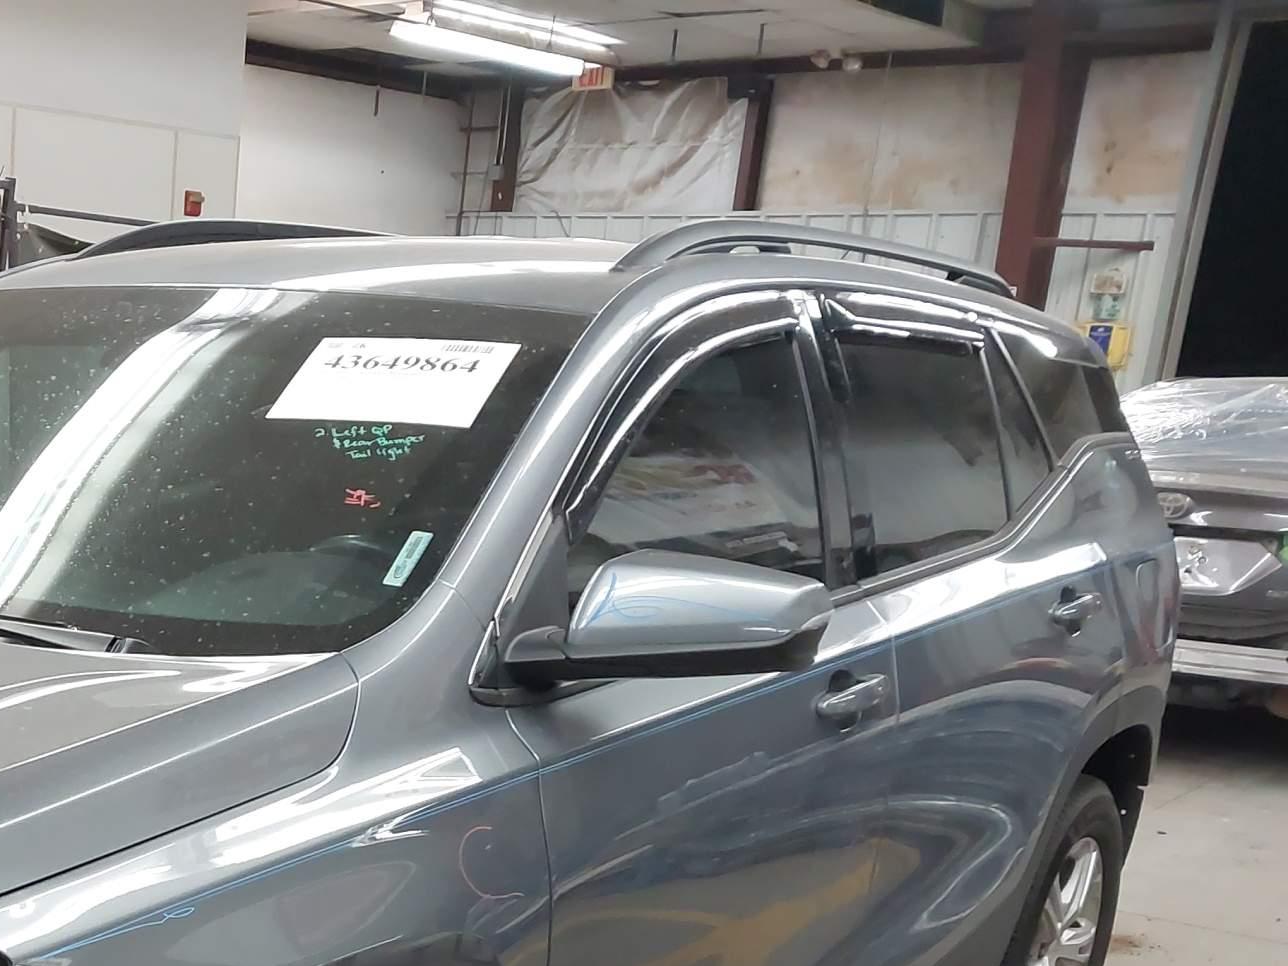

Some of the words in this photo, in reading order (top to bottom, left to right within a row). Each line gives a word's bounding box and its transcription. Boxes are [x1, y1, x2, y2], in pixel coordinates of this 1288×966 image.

[324, 354, 480, 372] 43649864
[331, 425, 367, 438] Left
[343, 439, 377, 448] Rear
[376, 434, 425, 447] Bumper
[345, 449, 371, 459] Tail
